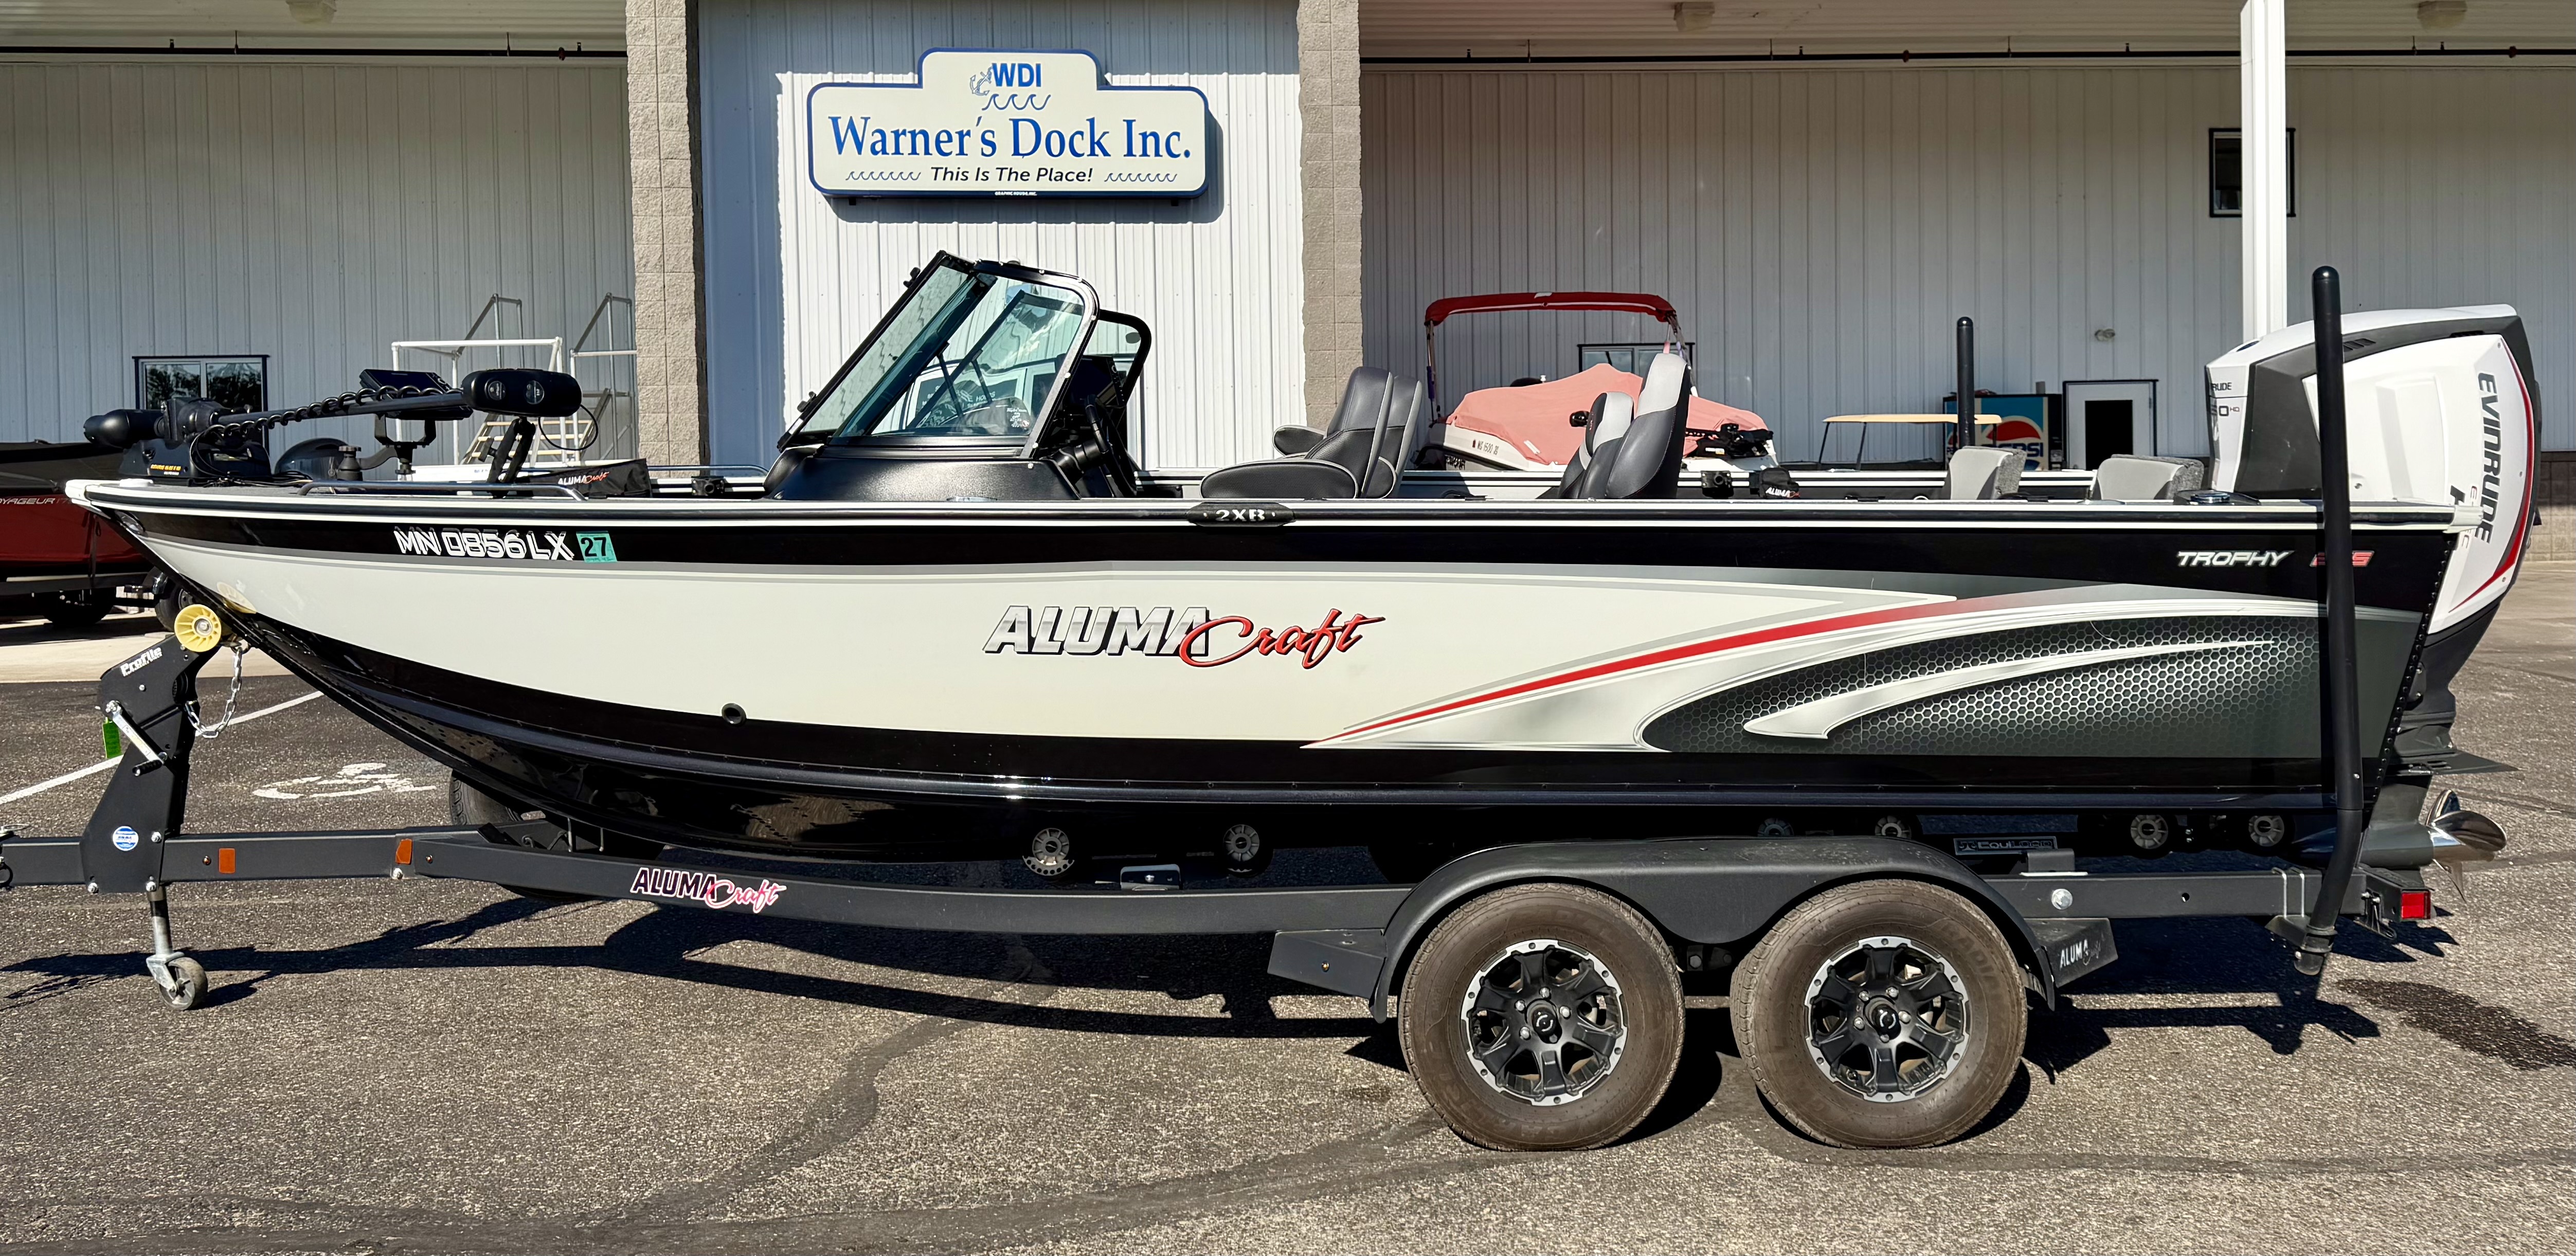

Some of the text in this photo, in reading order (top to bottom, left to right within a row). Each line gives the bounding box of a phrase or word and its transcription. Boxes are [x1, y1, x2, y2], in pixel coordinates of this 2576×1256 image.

[992, 63, 1041, 87] WDI
[828, 116, 1191, 158] Warner's Dock Inc.
[931, 167, 1093, 182] This Is The Place!
[2475, 372, 2502, 544] EVINRUDE
[393, 526, 607, 561] MN 0856 LX 27
[2177, 550, 2296, 568] TROPHY
[120, 647, 163, 677] Profile
